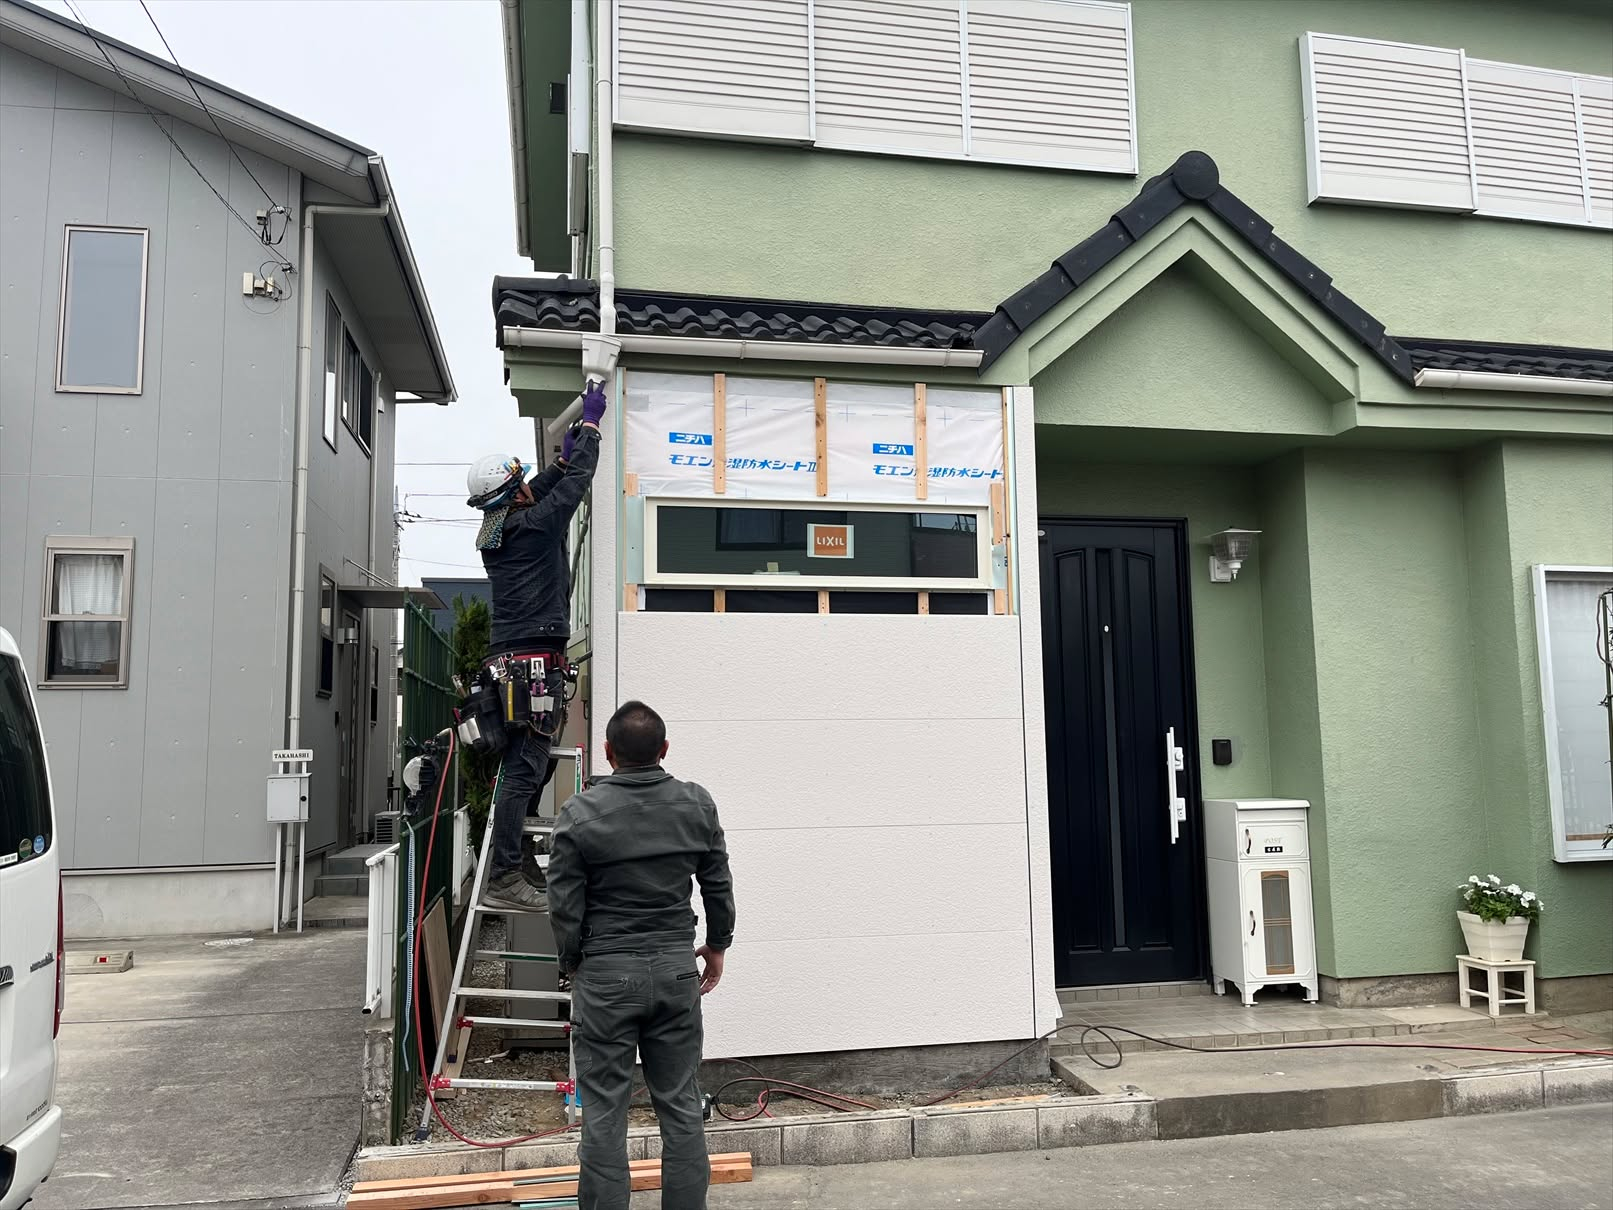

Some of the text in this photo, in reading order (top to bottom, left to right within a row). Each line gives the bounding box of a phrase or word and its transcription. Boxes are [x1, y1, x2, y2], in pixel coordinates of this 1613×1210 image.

[675, 433, 706, 445] ニチハ
[878, 444, 907, 455] ニチハ
[816, 536, 846, 547] LIXIL
